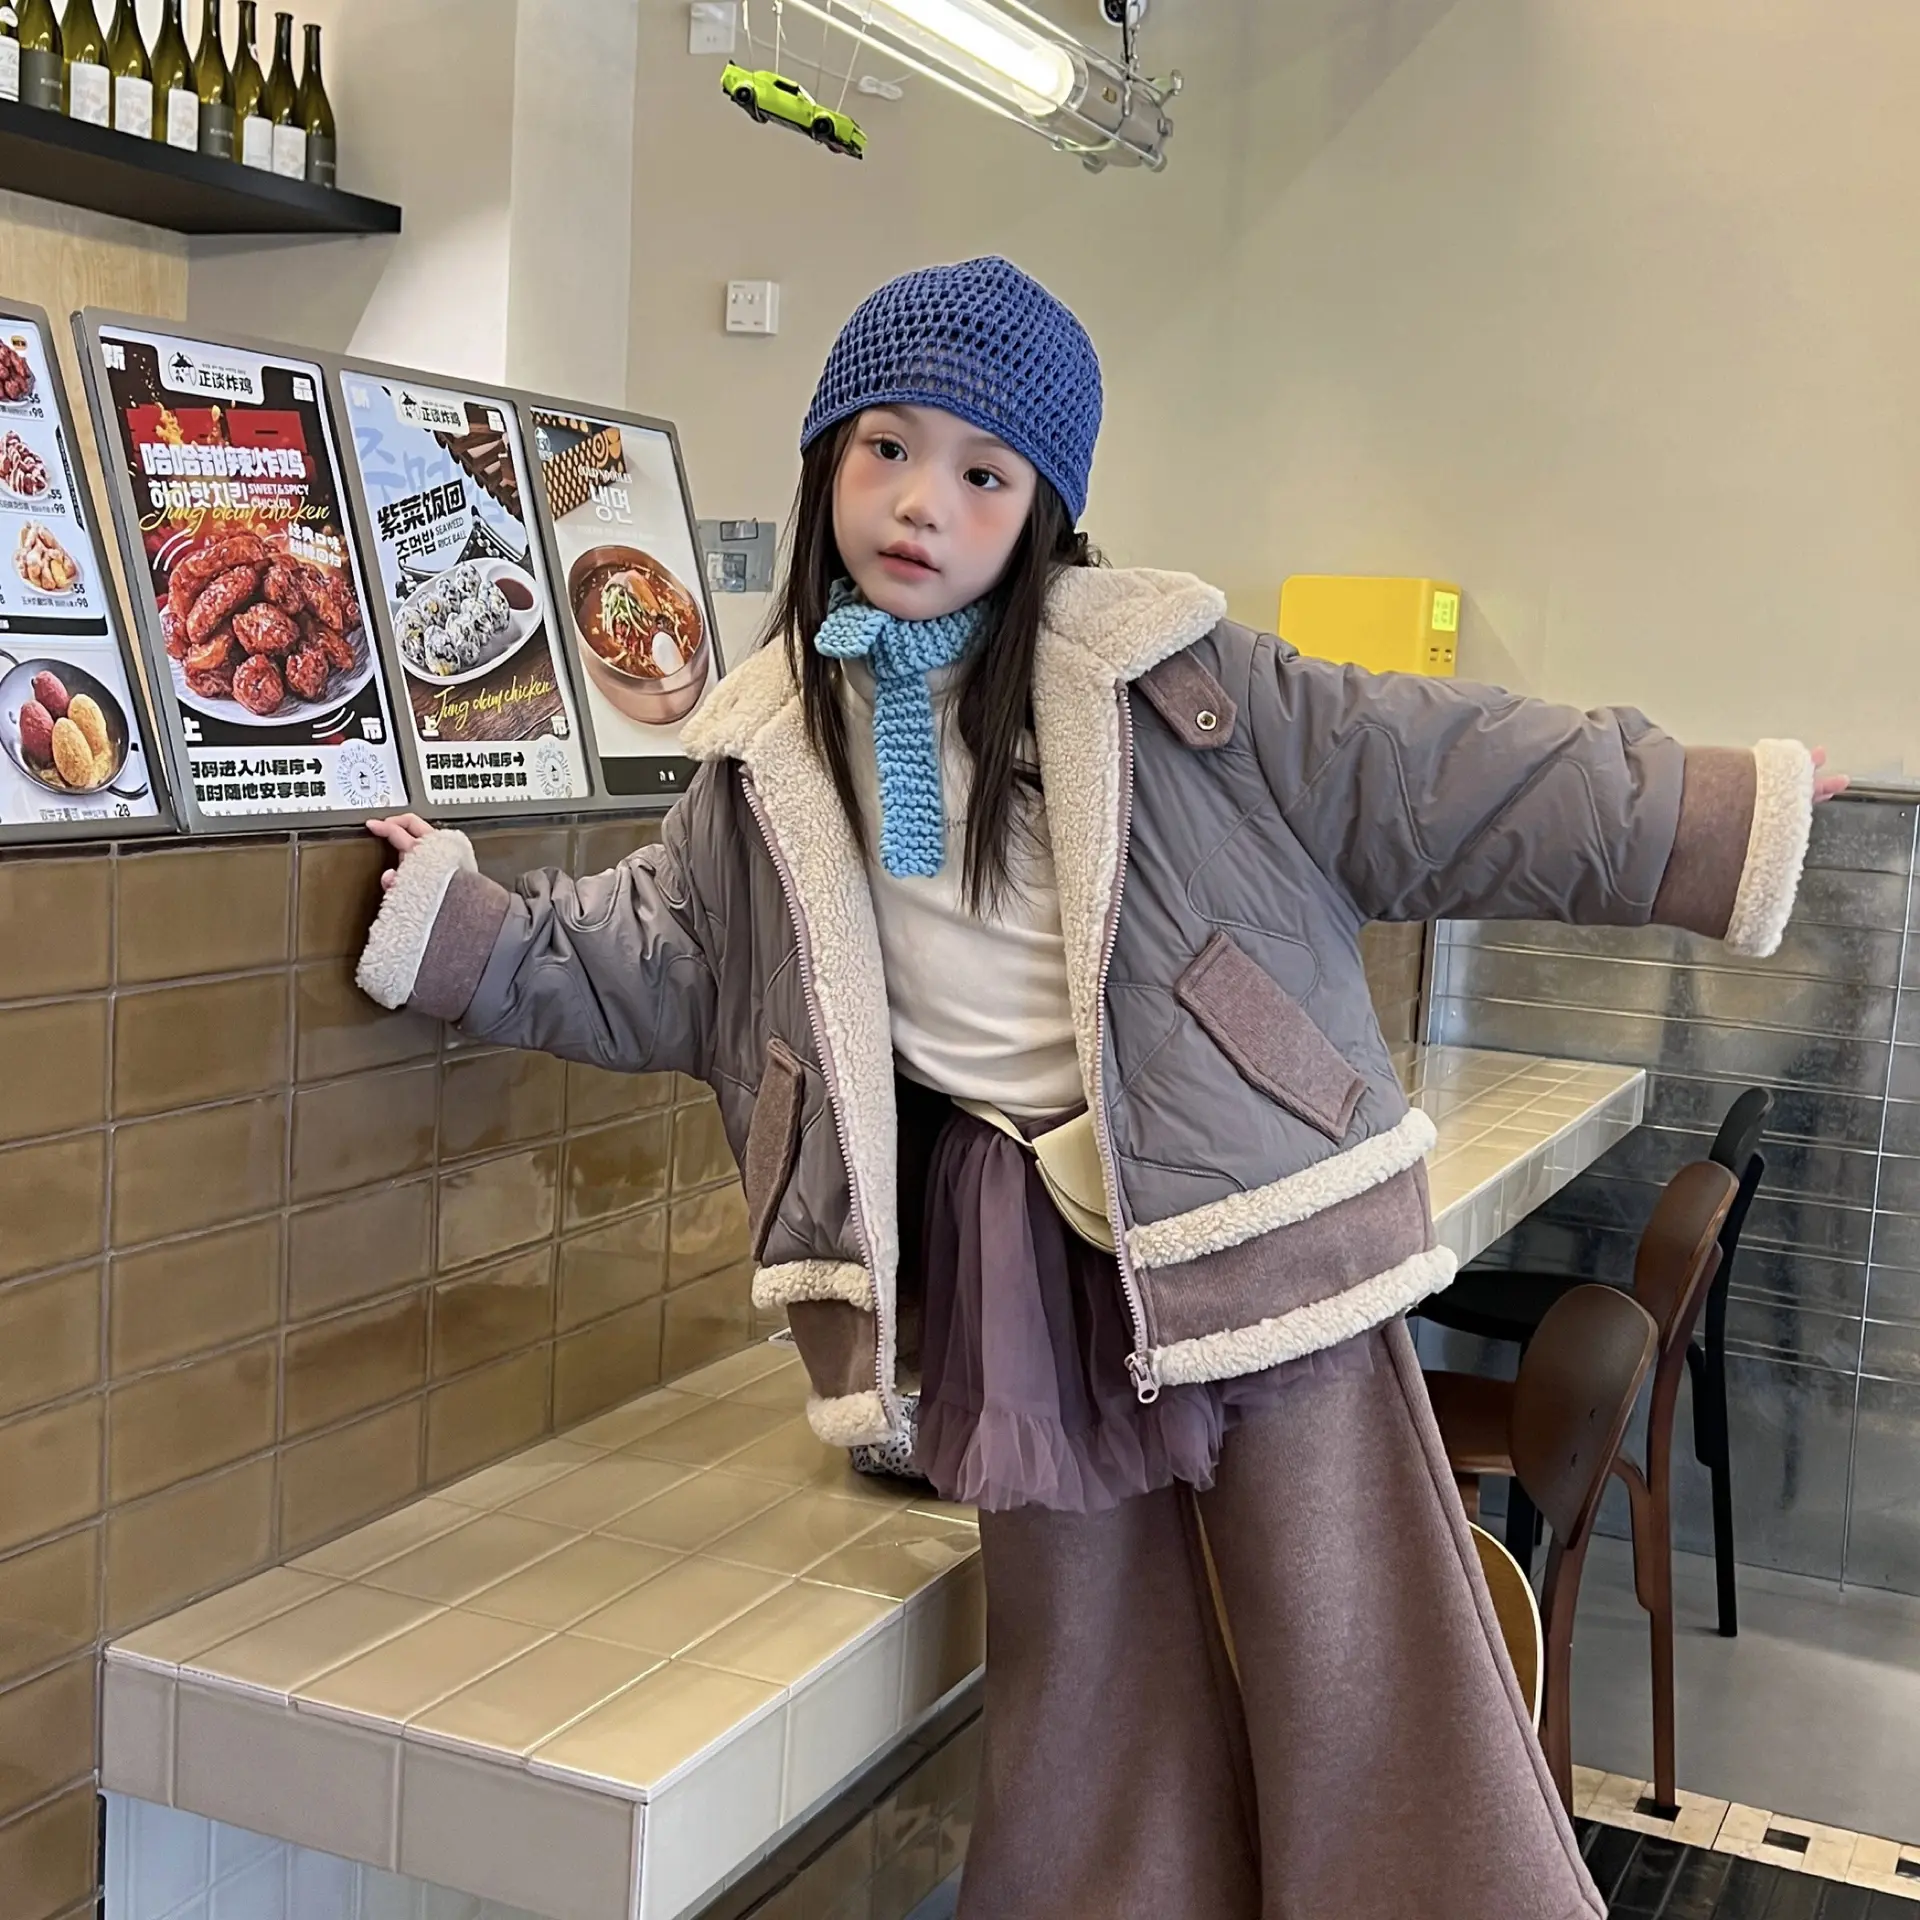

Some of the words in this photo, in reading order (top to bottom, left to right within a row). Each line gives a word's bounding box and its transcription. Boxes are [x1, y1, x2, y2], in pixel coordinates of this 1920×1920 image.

[198, 369, 253, 394] 正谈炸鸡
[140, 443, 306, 479] 哈哈甜辣炸鸡
[249, 484, 309, 496] SWEET&SPICY
[588, 480, 633, 525] 냉면
[377, 478, 466, 541] 紫菜饭团
[435, 517, 464, 535] SEAWEED
[395, 528, 437, 566] 주먹밥
